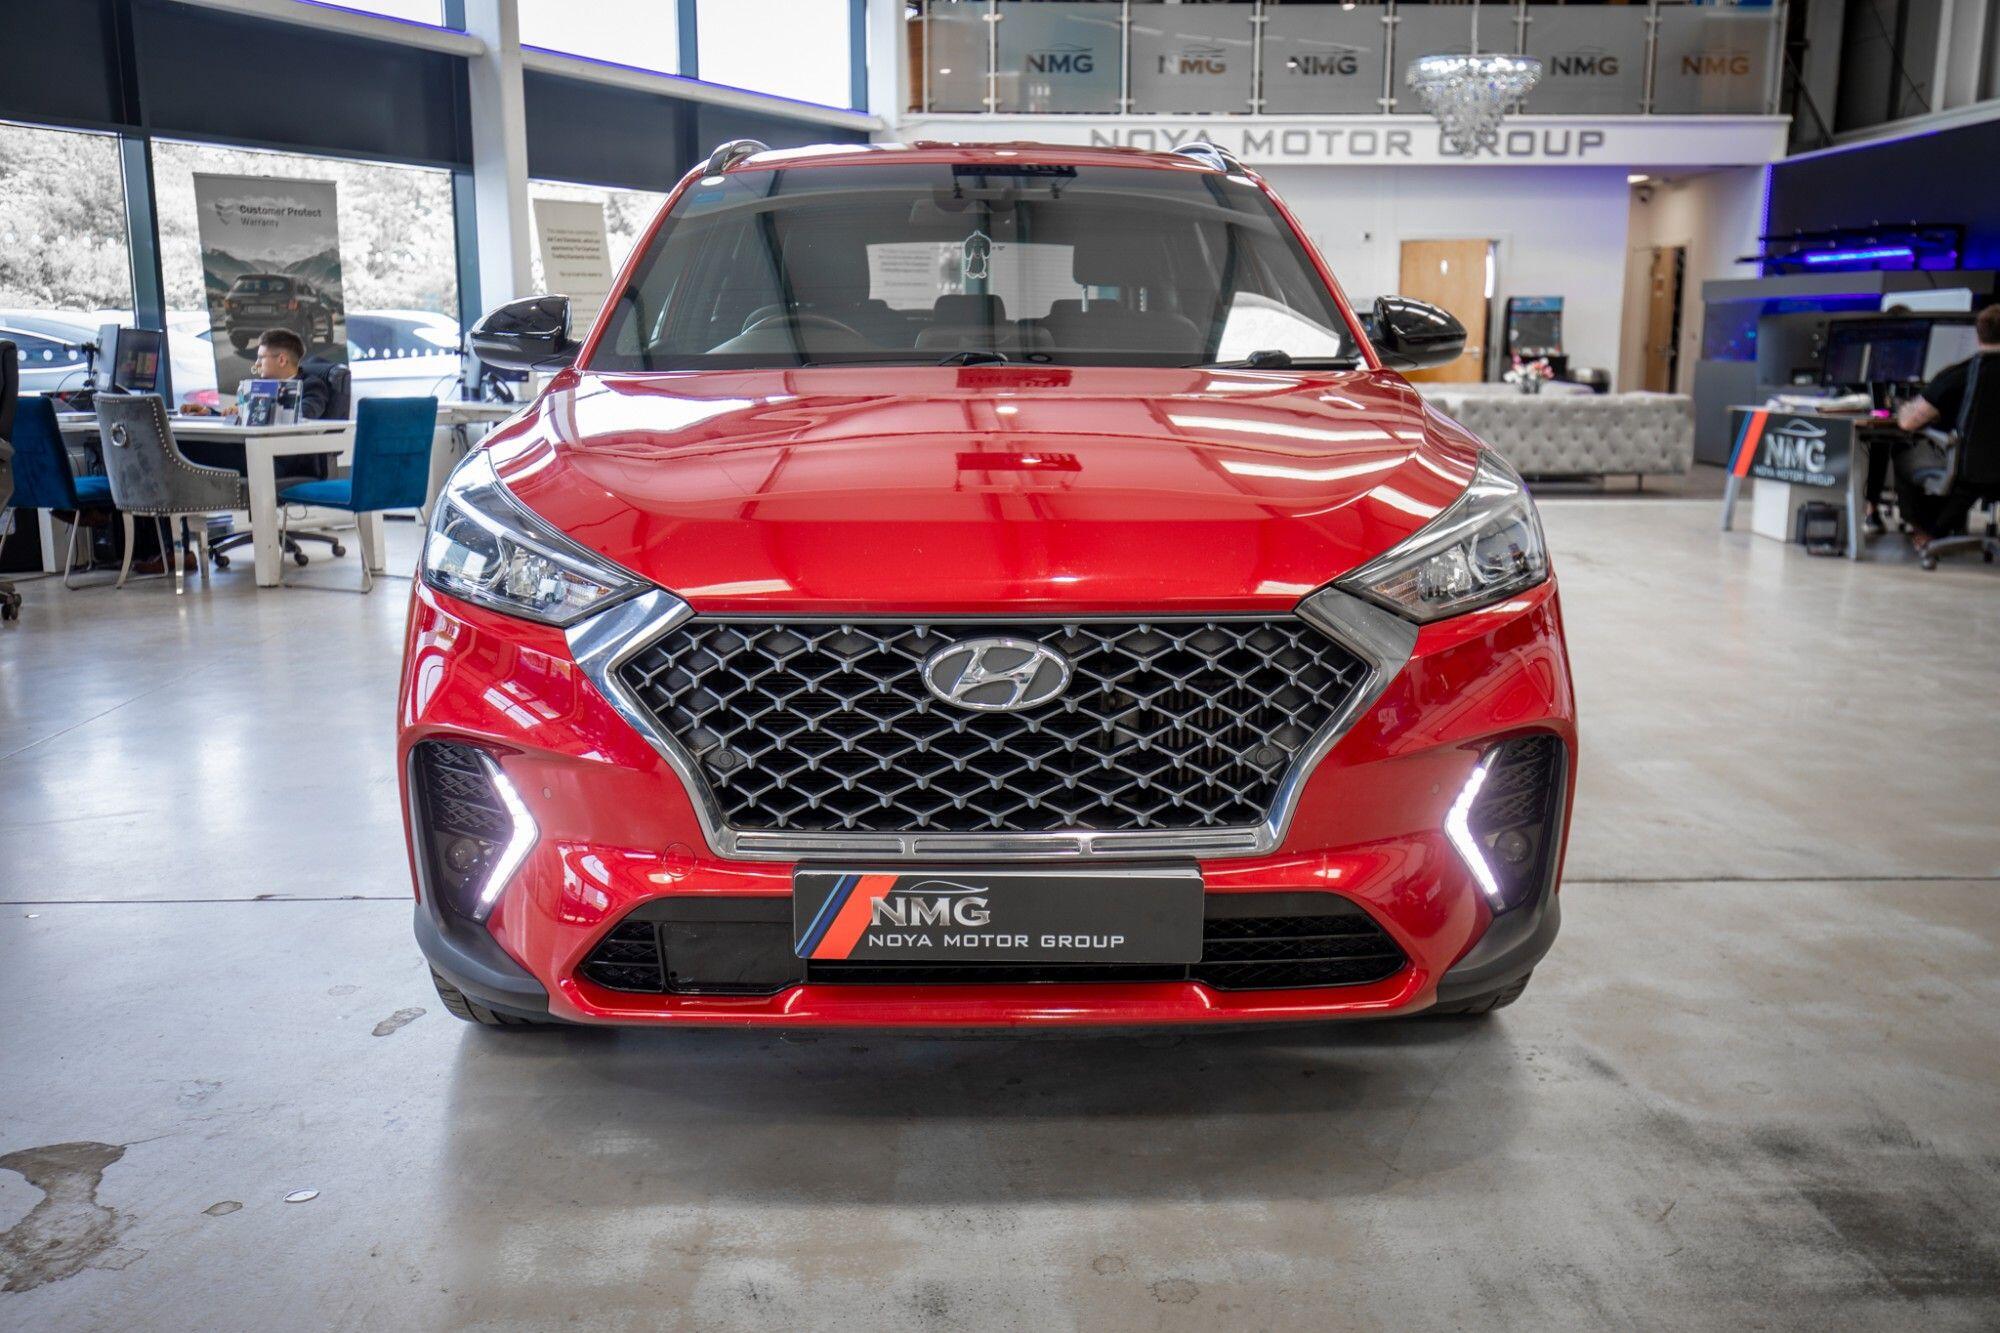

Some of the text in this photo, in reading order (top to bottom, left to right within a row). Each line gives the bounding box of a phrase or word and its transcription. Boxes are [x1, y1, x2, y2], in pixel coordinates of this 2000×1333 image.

[1026, 54, 1094, 74] NMG
[1290, 55, 1358, 75] NMG
[1550, 56, 1619, 76] NMG
[1681, 56, 1749, 76] NMG
[1243, 129, 1412, 156] MOTOR
[240, 205, 322, 217] Customer Protect
[240, 218, 279, 227] Warranty
[1764, 433, 1826, 473] NMG
[870, 897, 990, 927] NMG
[869, 935, 1125, 948] NOYA MOTOR GROUP
